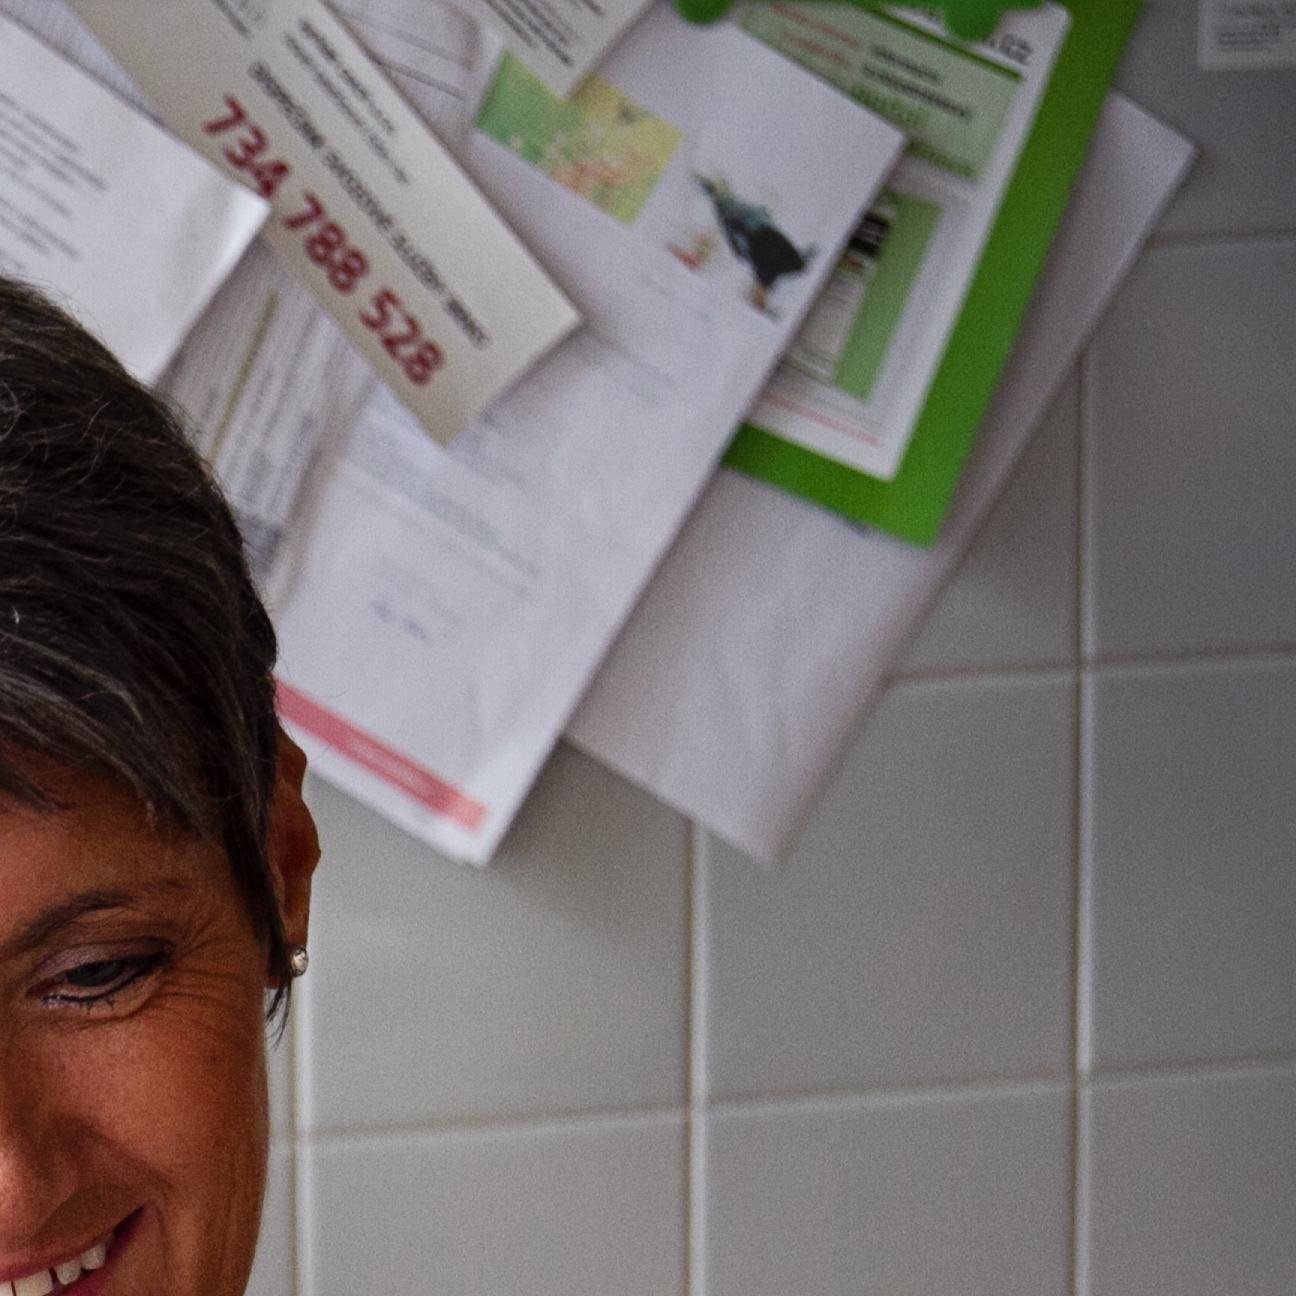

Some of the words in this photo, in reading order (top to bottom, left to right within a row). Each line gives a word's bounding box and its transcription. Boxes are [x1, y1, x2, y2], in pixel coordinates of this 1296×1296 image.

[199, 93, 293, 205] 734
[280, 191, 373, 300] 788
[355, 285, 450, 390] 528
